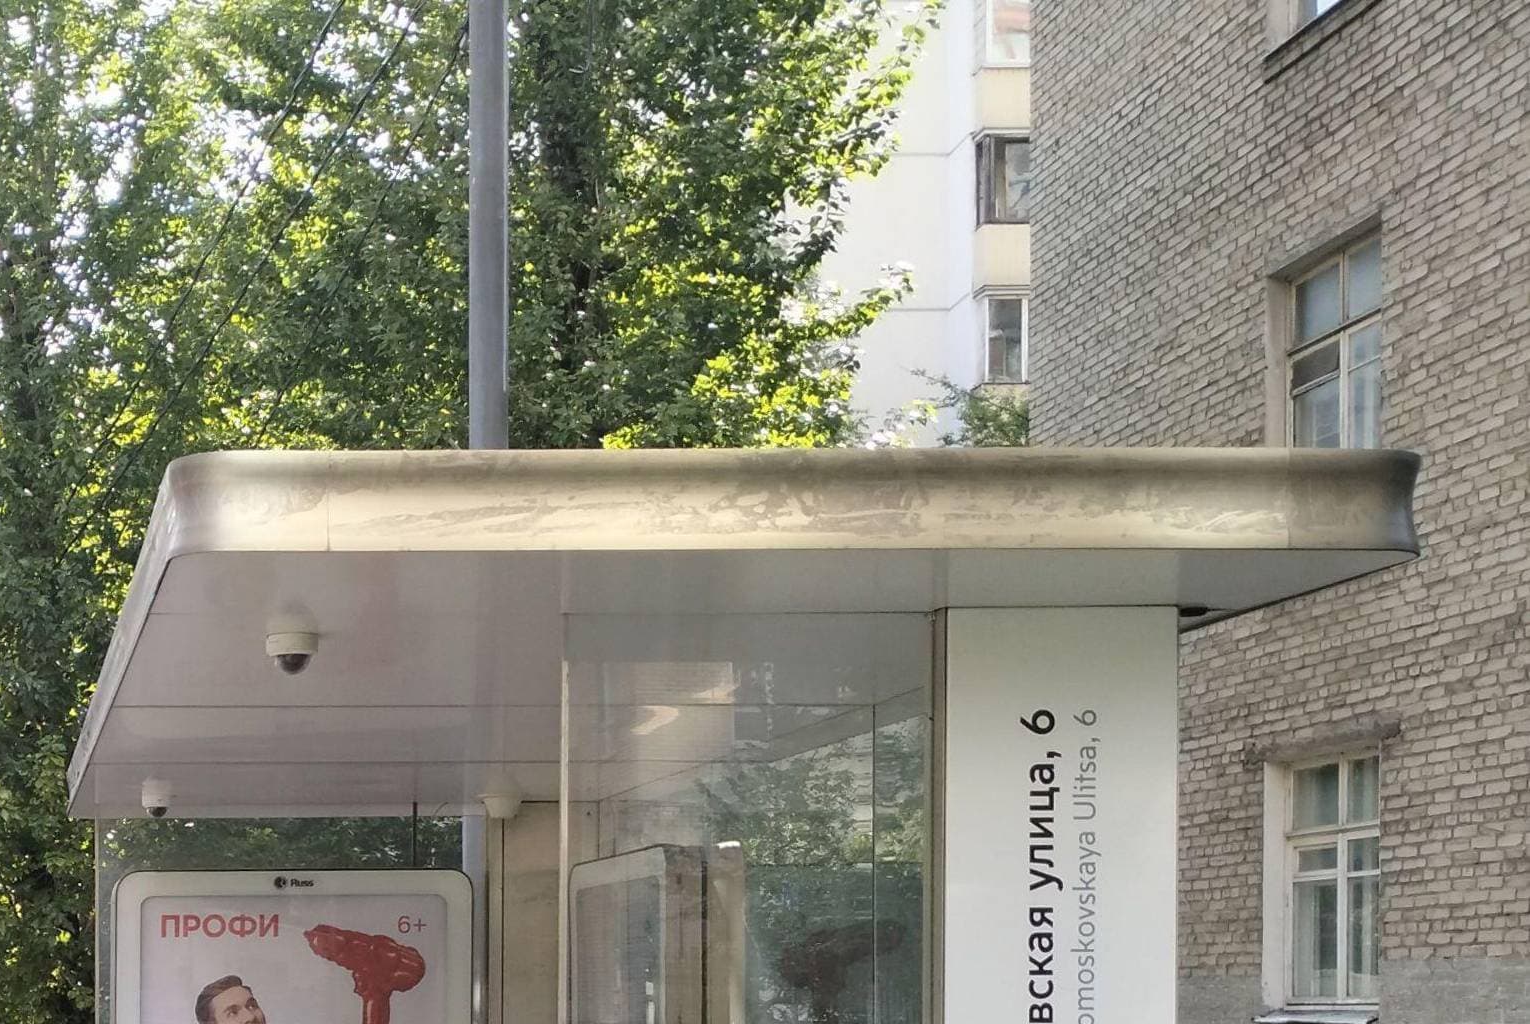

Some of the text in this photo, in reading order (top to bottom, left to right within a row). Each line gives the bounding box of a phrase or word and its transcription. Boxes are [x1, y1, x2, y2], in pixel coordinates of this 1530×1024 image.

[1020, 709, 1056, 735] 6
[1073, 709, 1097, 727] 6
[1072, 737, 1101, 820] Ulitsa,
[1029, 751, 1063, 891] улица,
[160, 914, 280, 938] ПРОФИ
[397, 915, 427, 934] 6+
